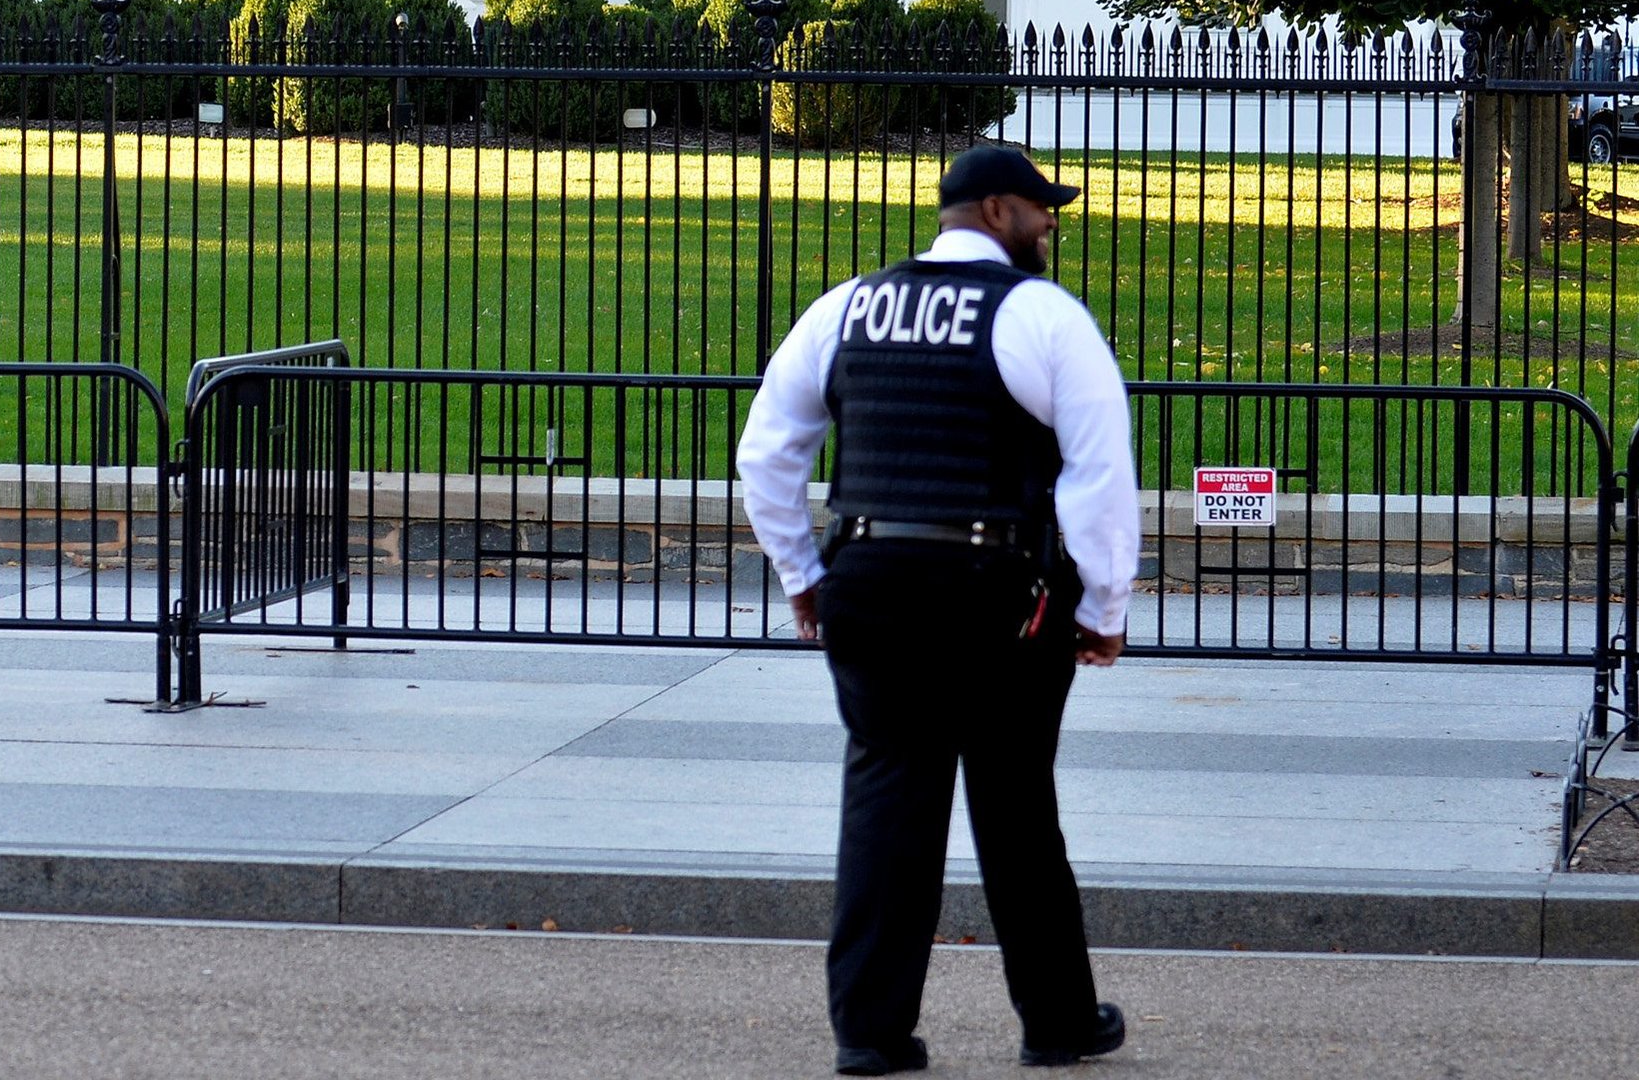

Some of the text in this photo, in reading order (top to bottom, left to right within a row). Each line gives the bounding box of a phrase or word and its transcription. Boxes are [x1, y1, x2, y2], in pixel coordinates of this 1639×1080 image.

[842, 282, 985, 345] POLICE
[1202, 473, 1268, 483] RESTRICTED
[1221, 483, 1249, 492] AREA
[1205, 495, 1266, 507] DO NOT
[1209, 509, 1262, 520] ENTER
